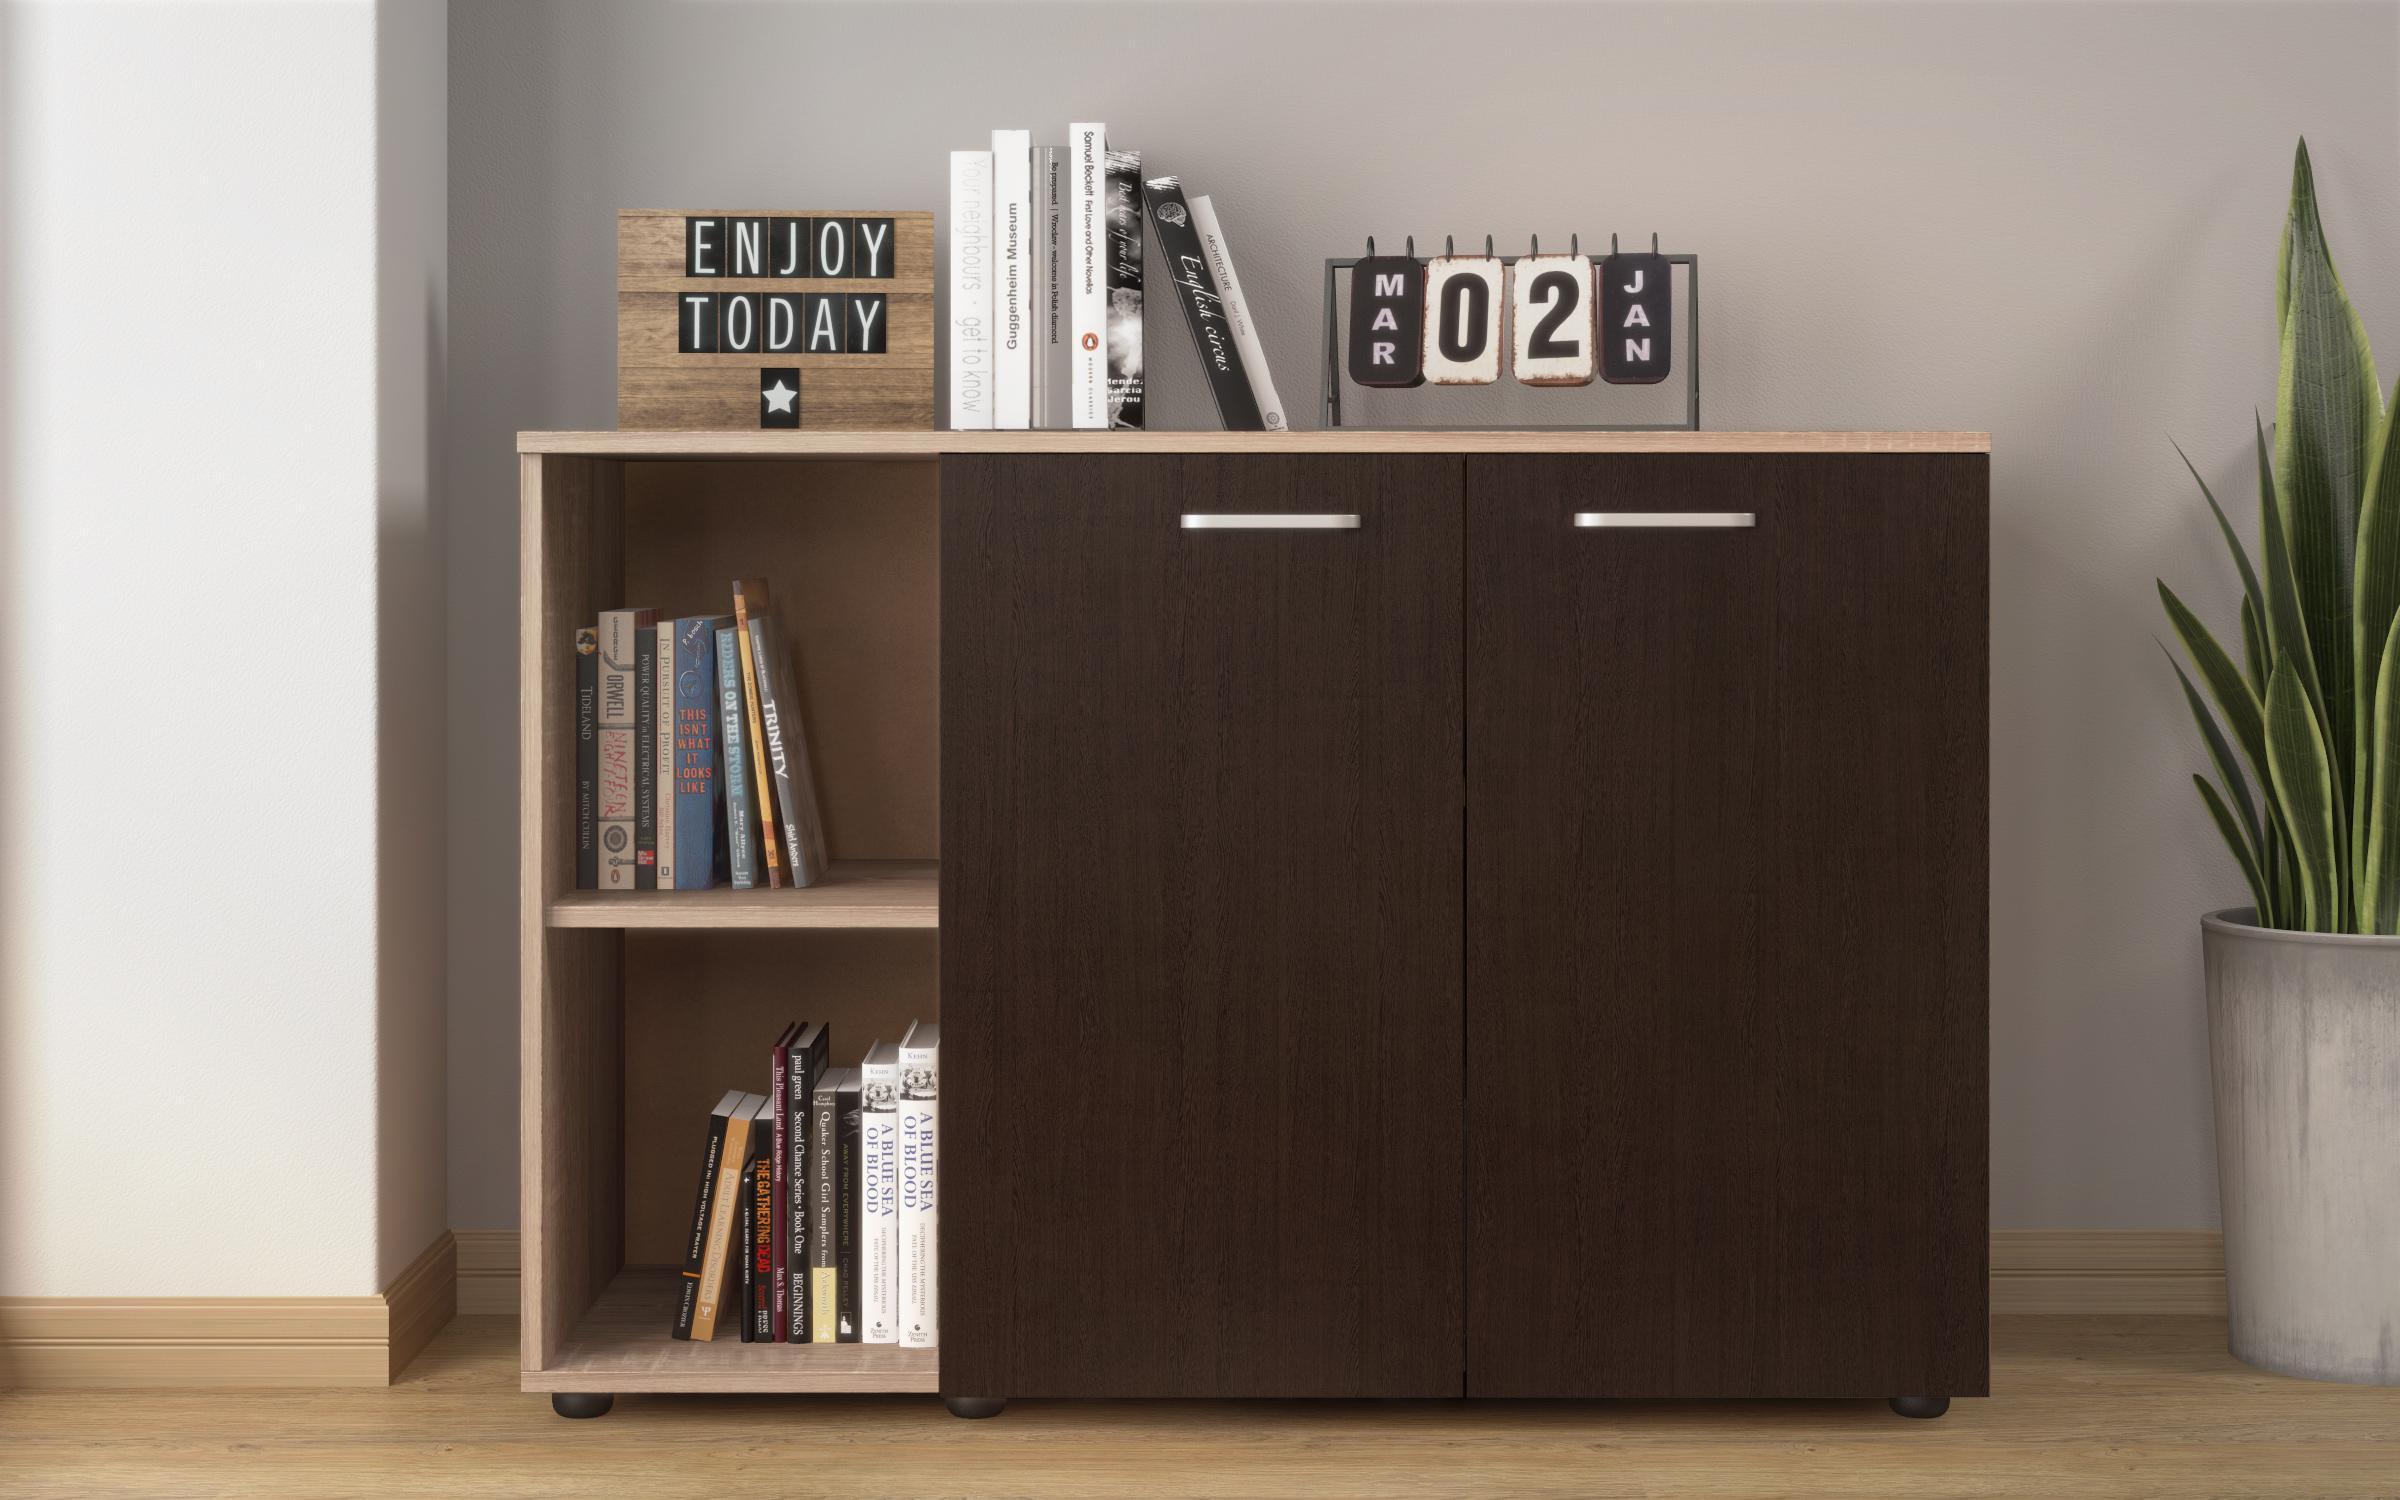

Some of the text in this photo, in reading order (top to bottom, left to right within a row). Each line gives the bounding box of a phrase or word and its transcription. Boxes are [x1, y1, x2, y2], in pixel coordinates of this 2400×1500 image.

[1084, 131, 1095, 163] Samuel
[1084, 165, 1095, 196] Beckett
[1085, 214, 1094, 229] Love
[1085, 231, 1094, 245] and
[695, 221, 887, 276] ENJOY
[955, 200, 989, 290] neighbours
[1085, 246, 1094, 265] Other
[1007, 203, 1020, 350] Guggenheim Museum
[1205, 234, 1233, 291] ARCHITECTURE
[686, 296, 880, 351] TODAY
[955, 318, 988, 341] get
[1174, 255, 1230, 371] English circus
[1371, 274, 1404, 365] MAR
[1623, 270, 1651, 362] JAN
[962, 349, 988, 365] to
[962, 370, 988, 412] know
[641, 654, 650, 684] POWER
[720, 632, 737, 689] RIDERS
[606, 674, 624, 719] ORWELL
[640, 686, 650, 723] QUALITY
[660, 638, 671, 776] IN PURSUIT OF PROFIT
[724, 691, 737, 711] ON
[680, 709, 707, 721] THIS
[726, 713, 740, 744] THE
[678, 738, 711, 750] WHAT
[763, 698, 789, 779] TRINITY
[581, 686, 593, 849] TIDELAND BY MITCH CULLIN
[641, 735, 650, 787] ELECTRICAL
[676, 767, 712, 779] LOOKS
[686, 752, 699, 765] IT
[728, 746, 744, 798] STORM
[680, 781, 706, 793] LIKE
[641, 789, 650, 828] SYSTEMS
[785, 823, 800, 867] Shirl Anders
[775, 1066, 784, 1082] This
[792, 1055, 805, 1100] paul green
[775, 1083, 784, 1111] Pleasant
[775, 1113, 784, 1130] Land
[819, 1111, 831, 1146] Quaker
[707, 1136, 718, 1168] PLUGGED
[821, 1149, 831, 1179] School
[904, 1115, 917, 1208] OF BLOOD
[920, 1112, 934, 1212] A BLUE SEA
[757, 1159, 770, 1180] THE
[867, 1127, 879, 1213] OF BLOOD
[881, 1124, 894, 1217] A BLUE SEA
[821, 1182, 831, 1203] Girl
[696, 1200, 707, 1231] VOLTAGE
[756, 1180, 770, 1243] GATHERING
[793, 1111, 805, 1335] Second Chance Series Book One BEGINNINGS
[819, 1206, 831, 1247] Samplers
[692, 1232, 703, 1259] PRAYER
[757, 1245, 771, 1273] DEAD
[821, 1249, 829, 1267] from
[776, 1267, 784, 1280] Max
[776, 1289, 785, 1313] Thomas
